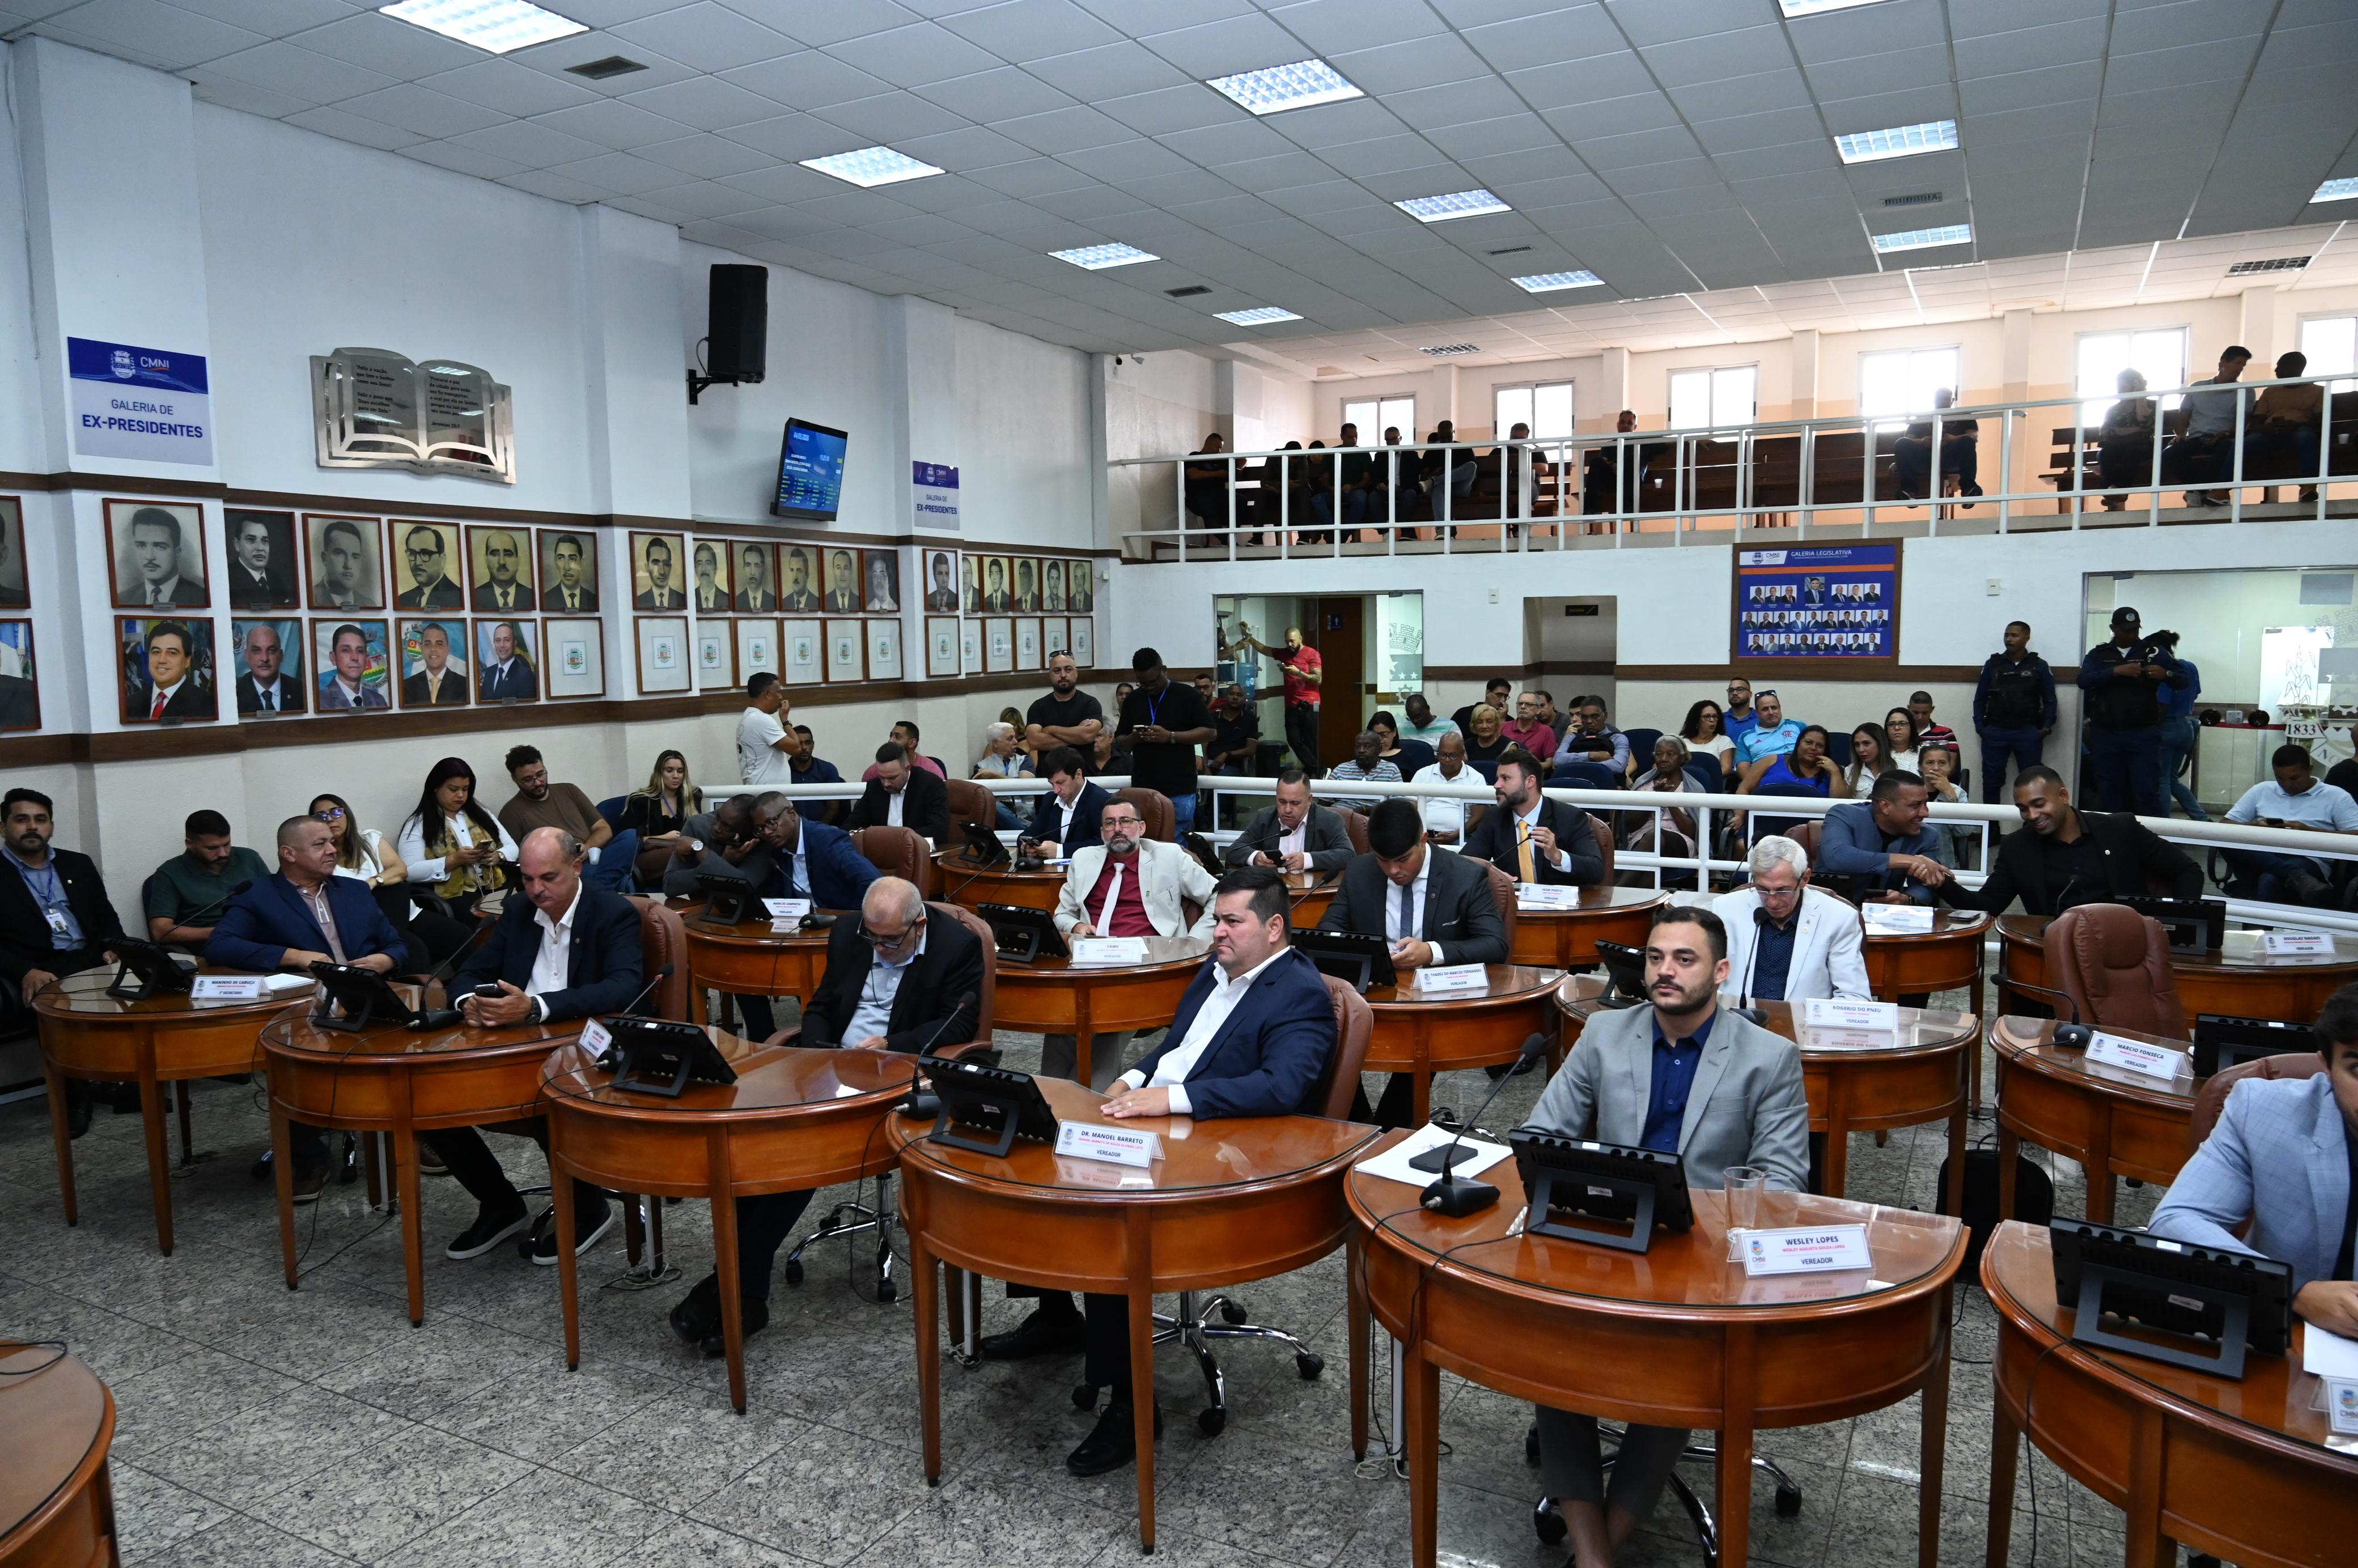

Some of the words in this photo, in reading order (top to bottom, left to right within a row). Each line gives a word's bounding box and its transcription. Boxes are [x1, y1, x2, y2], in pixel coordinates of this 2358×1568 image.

[141, 357, 169, 368] CMNI
[111, 400, 157, 414] GALERIA
[160, 405, 173, 415] DE
[82, 414, 203, 438] EX-PRESIDENTES
[917, 504, 957, 515] EX-PRESIDENTES
[2288, 724, 2316, 736] 1833
[2117, 1044, 2138, 1052] MARCIO
[2139, 1049, 2164, 1059] FONSECA
[2124, 1060, 2147, 1069] VEREADOR
